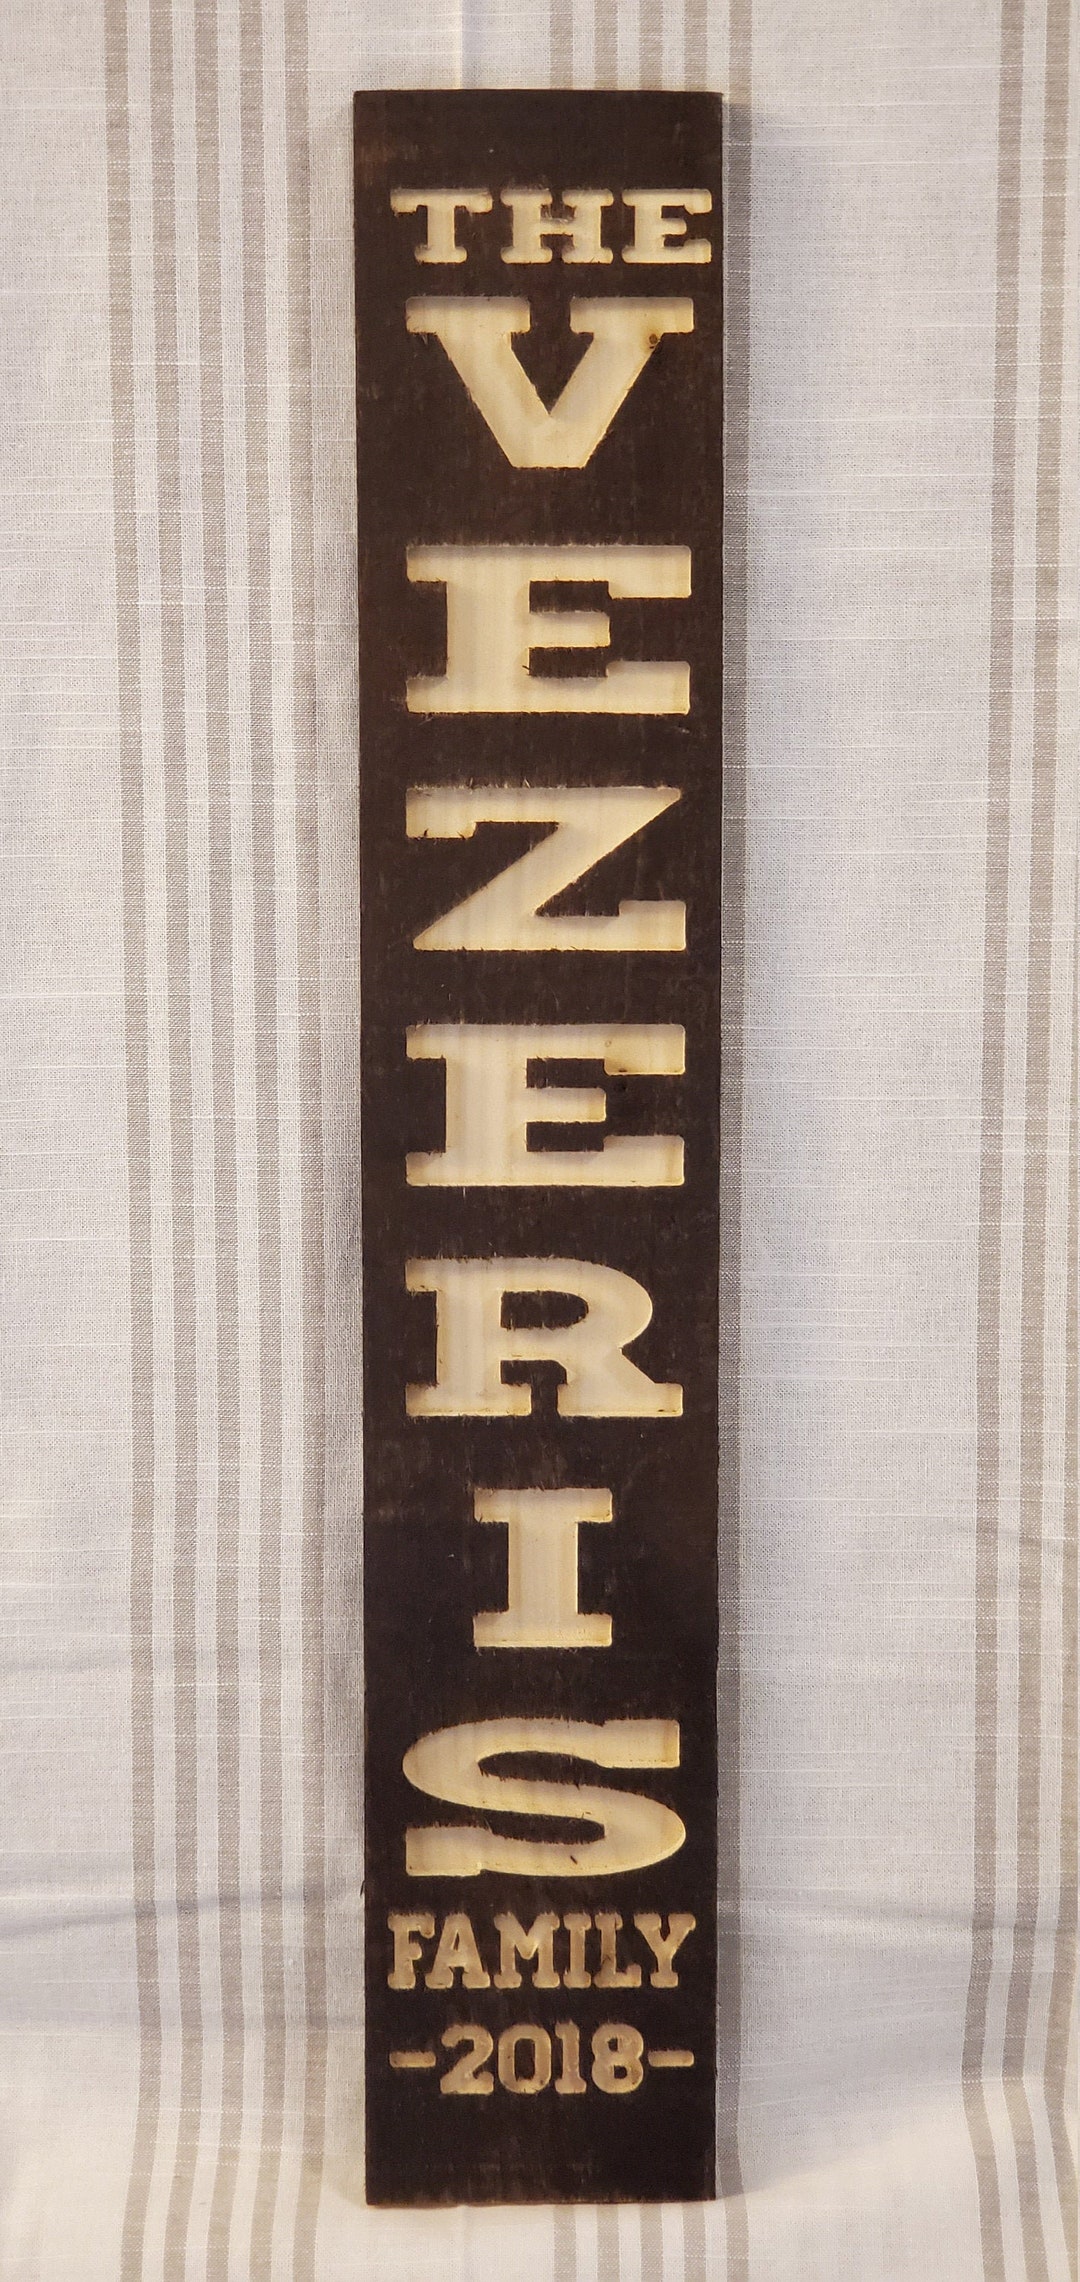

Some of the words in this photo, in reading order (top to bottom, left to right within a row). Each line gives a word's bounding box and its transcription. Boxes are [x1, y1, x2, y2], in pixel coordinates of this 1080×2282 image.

[389, 187, 713, 264] THE
[403, 296, 695, 1878] VEZERIS
[386, 1911, 697, 1990] FAMILY
